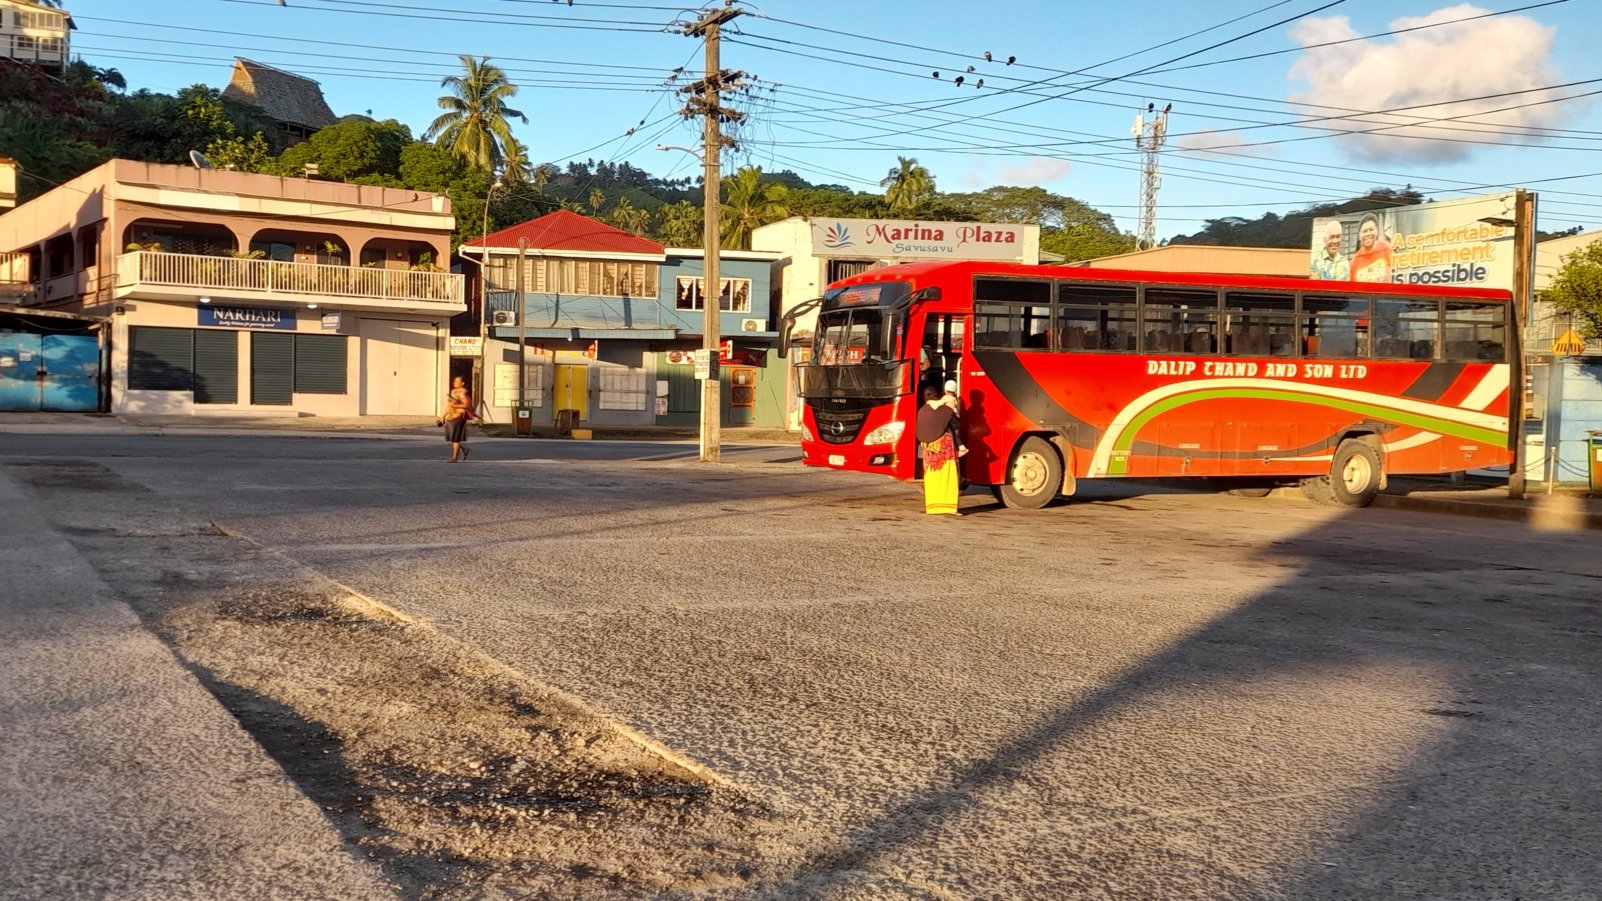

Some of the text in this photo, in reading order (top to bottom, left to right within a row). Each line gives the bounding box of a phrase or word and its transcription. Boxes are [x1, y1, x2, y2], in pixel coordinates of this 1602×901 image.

[866, 223, 1016, 248] Marina Plaza
[1392, 224, 1505, 249] A comfortable
[892, 243, 953, 254] Savusavu
[1391, 240, 1494, 268] retirement
[1391, 269, 1404, 284] is
[1408, 263, 1487, 285] possible
[213, 308, 280, 322] NARHARI
[1147, 360, 1367, 379] DALIP CHAND AND SON LTD
